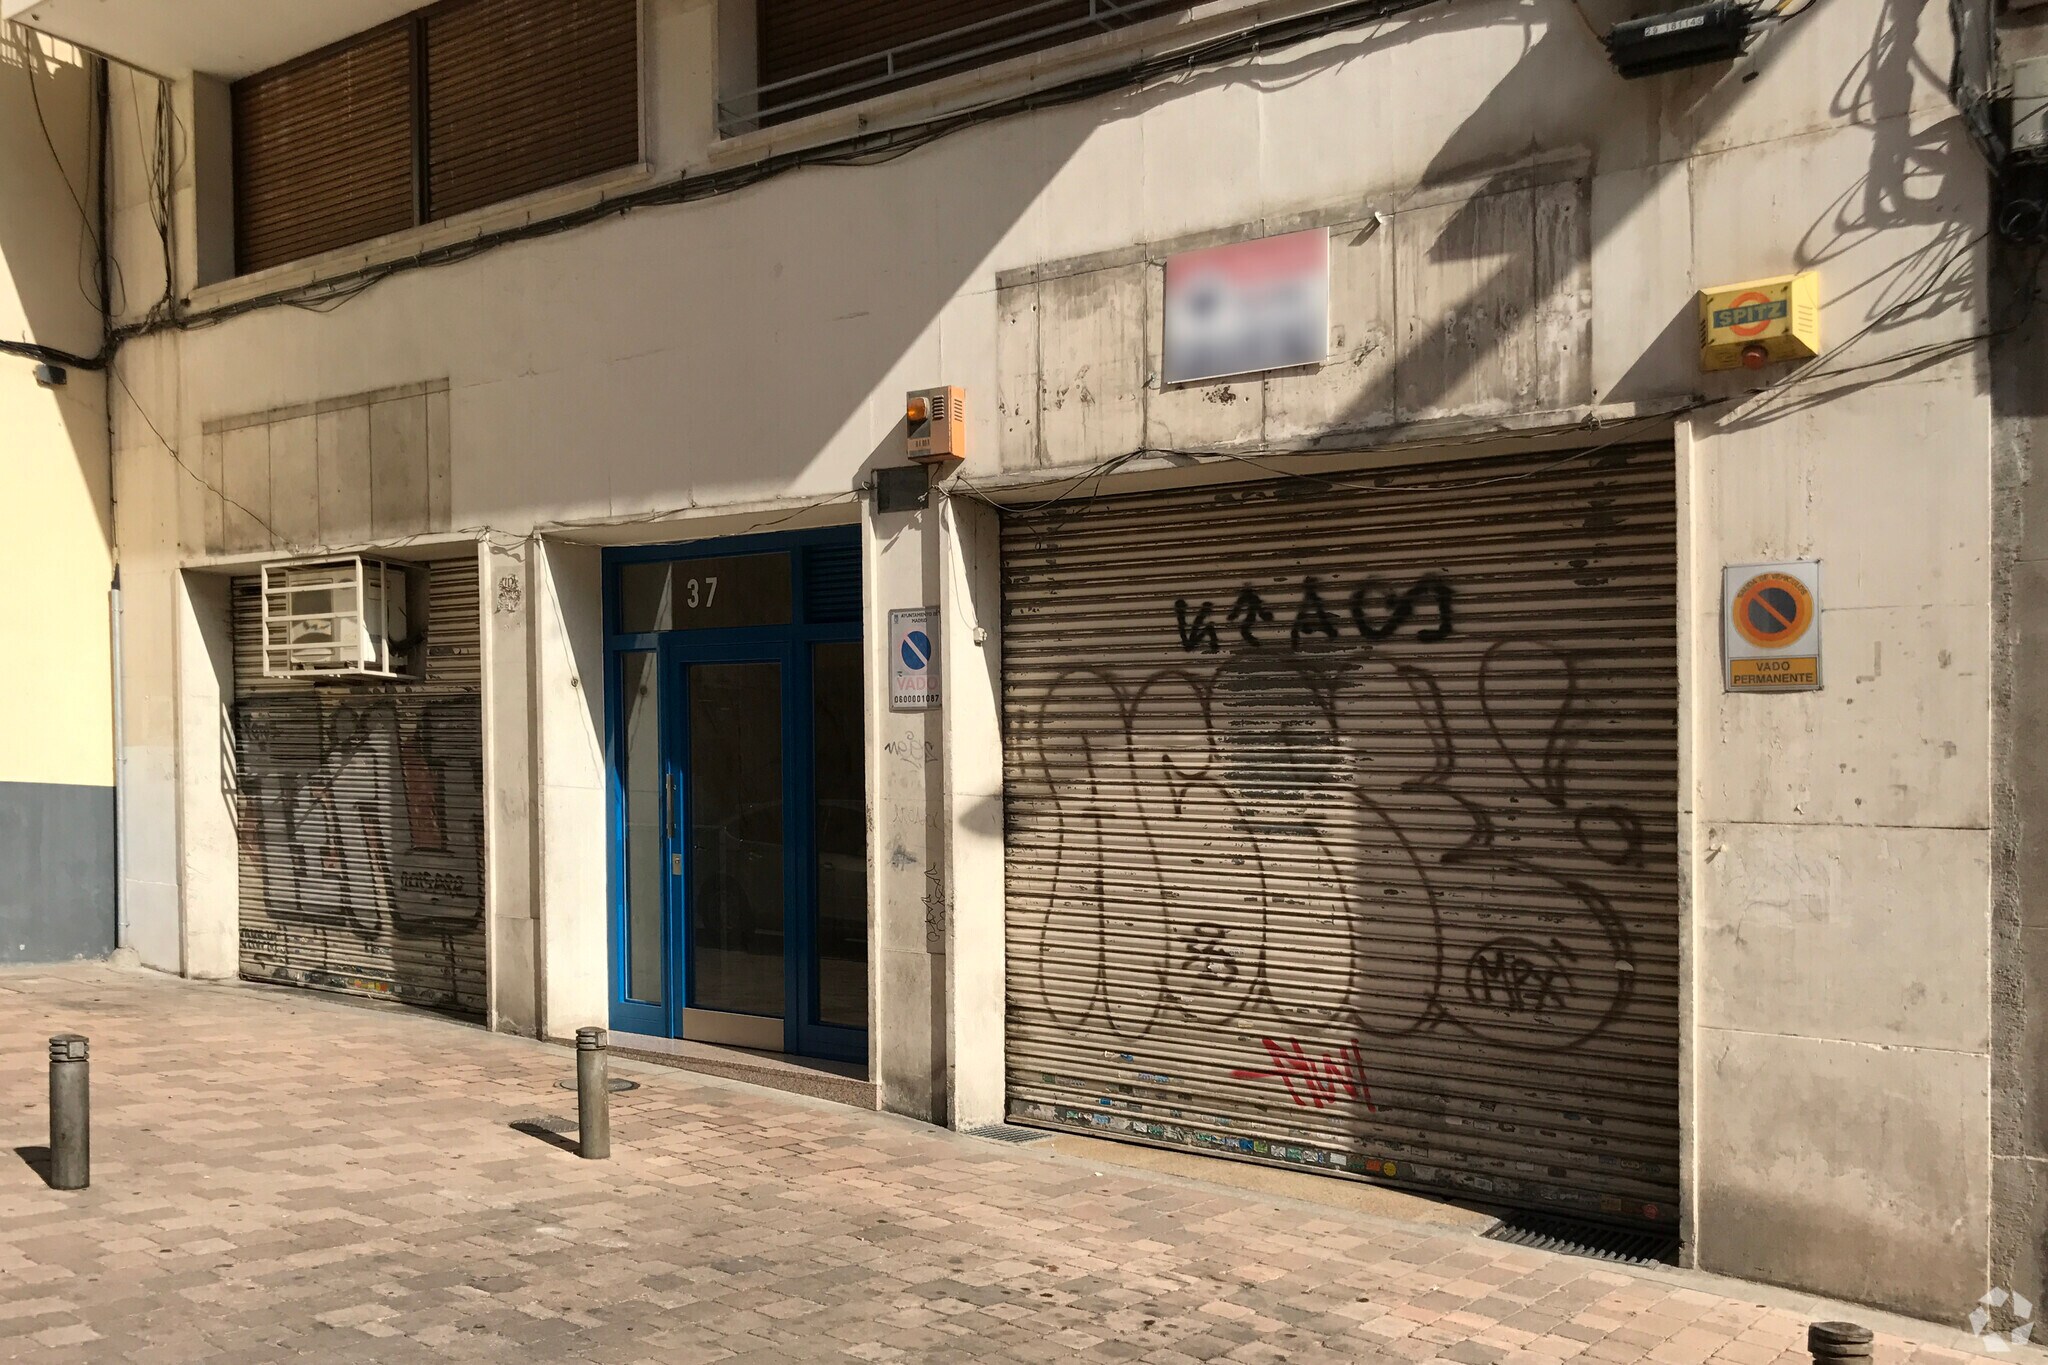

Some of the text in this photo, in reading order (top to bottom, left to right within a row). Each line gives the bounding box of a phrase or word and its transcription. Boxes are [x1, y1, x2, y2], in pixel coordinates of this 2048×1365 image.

[1718, 303, 1782, 326] SPITZ
[687, 576, 718, 609] 37
[1755, 661, 1791, 672] VADO
[897, 675, 939, 691] VADO
[1733, 672, 1814, 685] PERMANENTE
